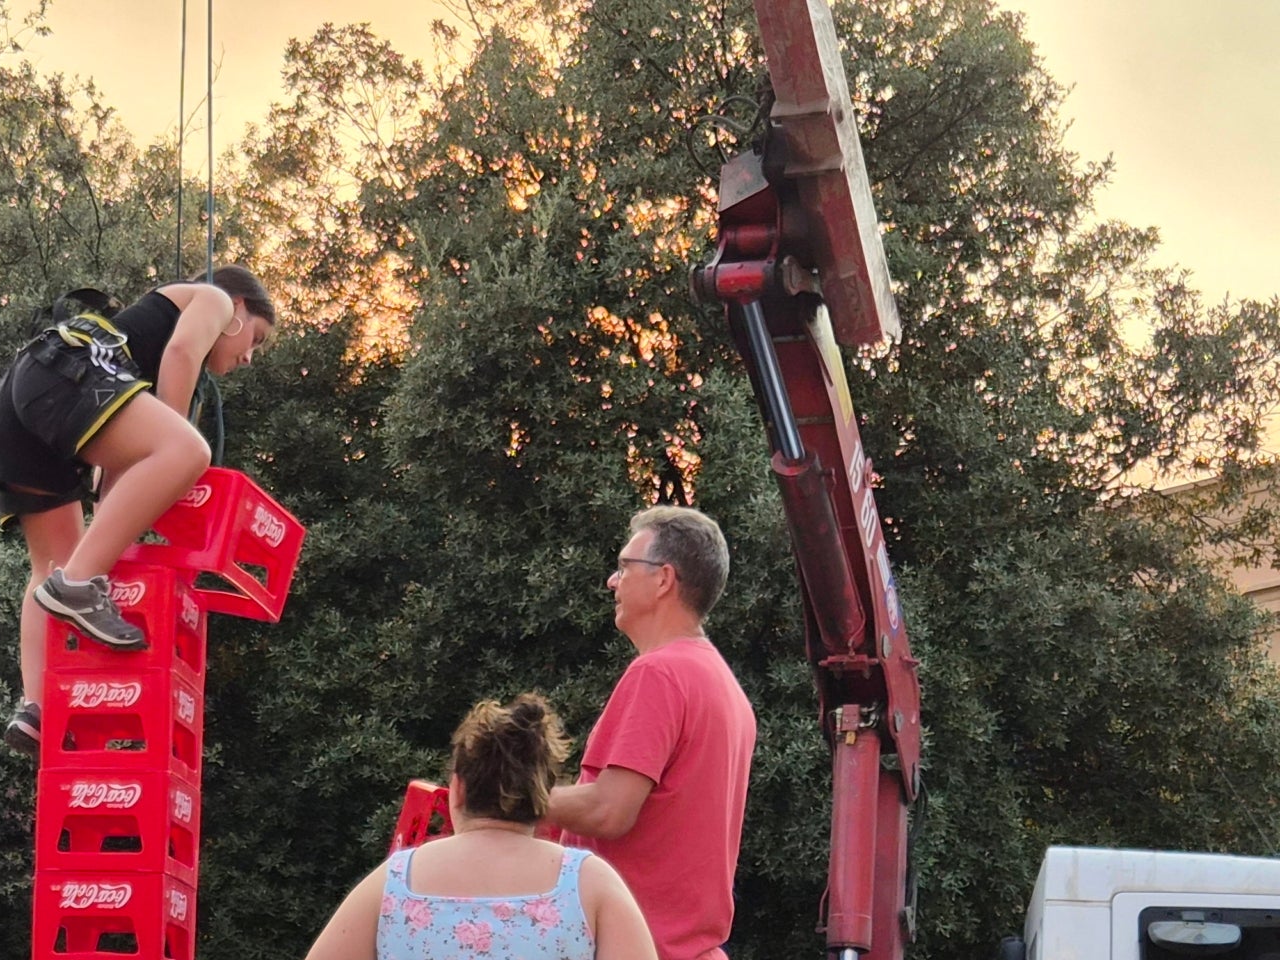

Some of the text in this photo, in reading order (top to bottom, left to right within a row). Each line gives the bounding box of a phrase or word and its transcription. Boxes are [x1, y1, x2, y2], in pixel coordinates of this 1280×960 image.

[70, 682, 141, 707] Coca-Cola
[69, 783, 141, 808] Coca-Cola
[60, 882, 132, 908] Coca-Cola
